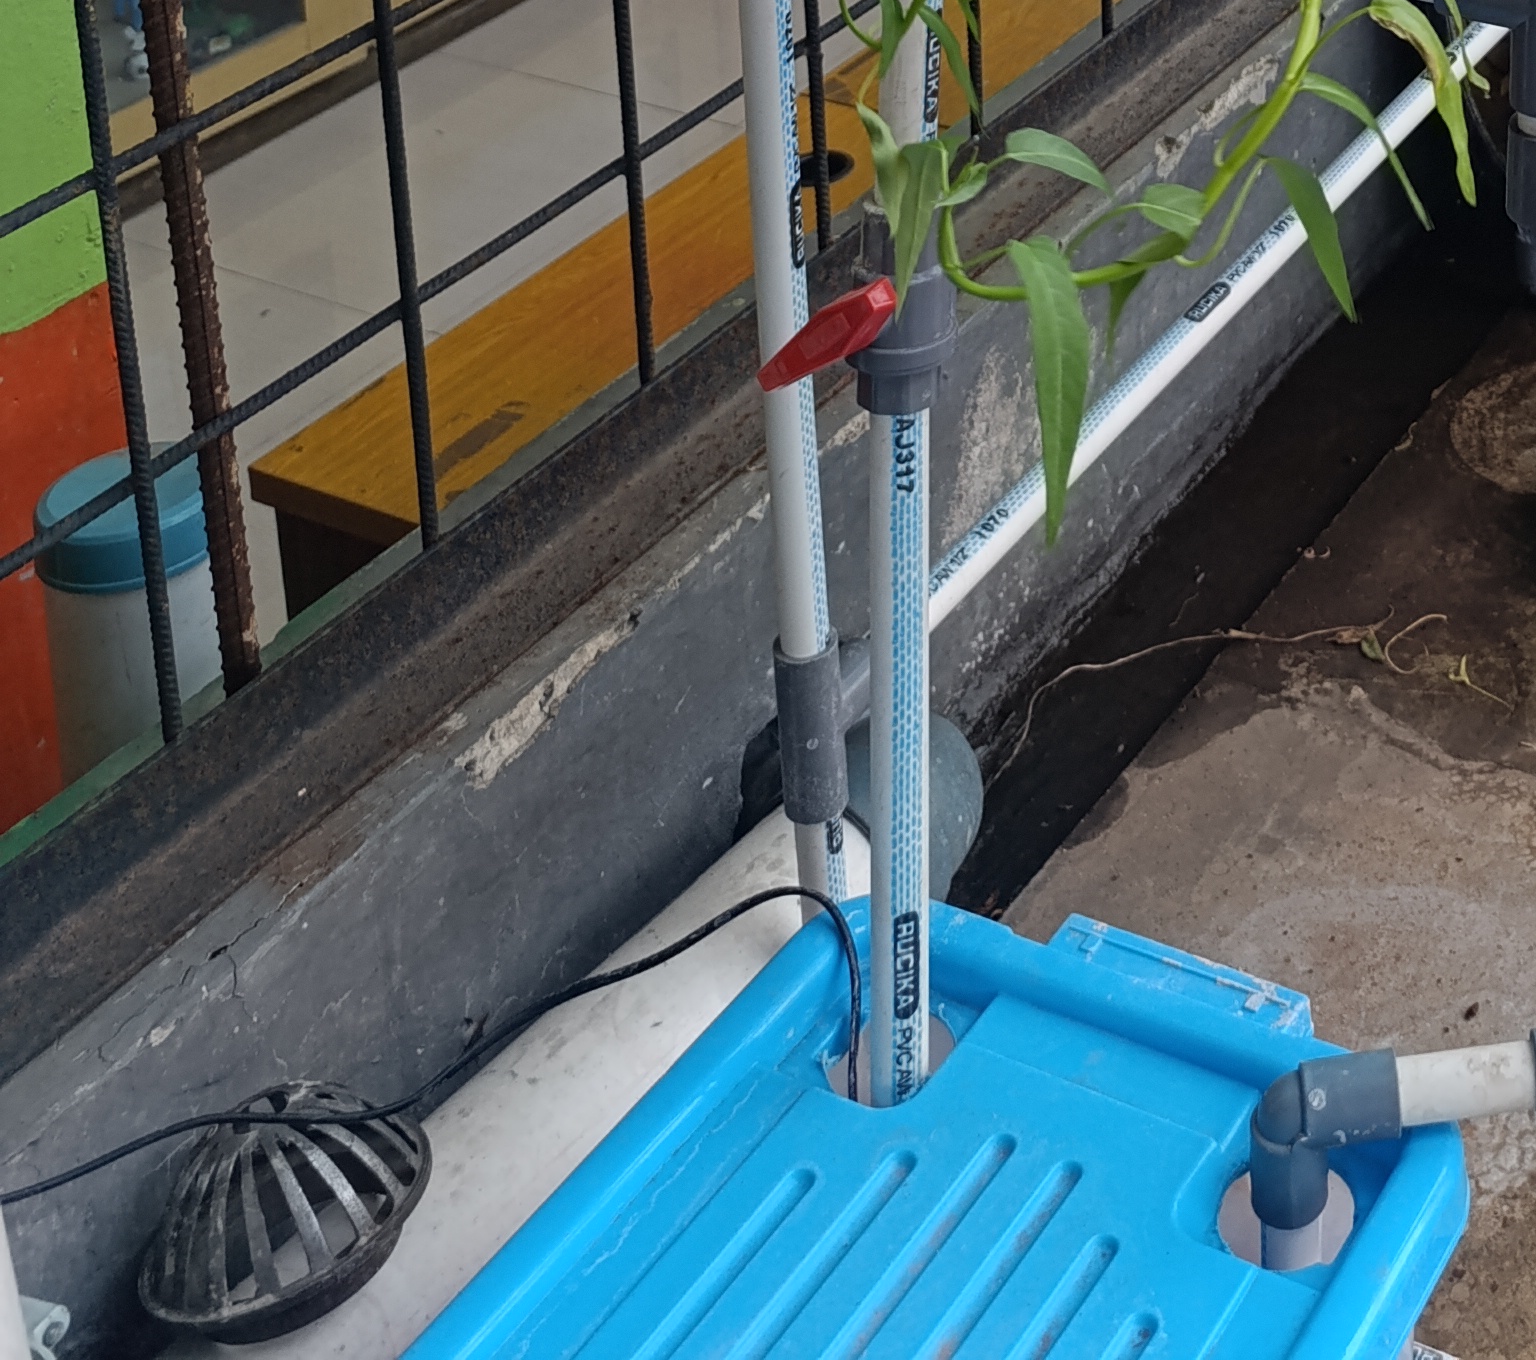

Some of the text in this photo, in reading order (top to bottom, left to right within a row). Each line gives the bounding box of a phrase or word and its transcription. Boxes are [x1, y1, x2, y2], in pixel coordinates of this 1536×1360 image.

[1187, 284, 1228, 319] RUCIKA
[895, 418, 915, 493] AJ317
[974, 508, 1009, 539] 1070
[896, 921, 915, 1011] RUCIKA
[895, 1026, 914, 1067] PVC
